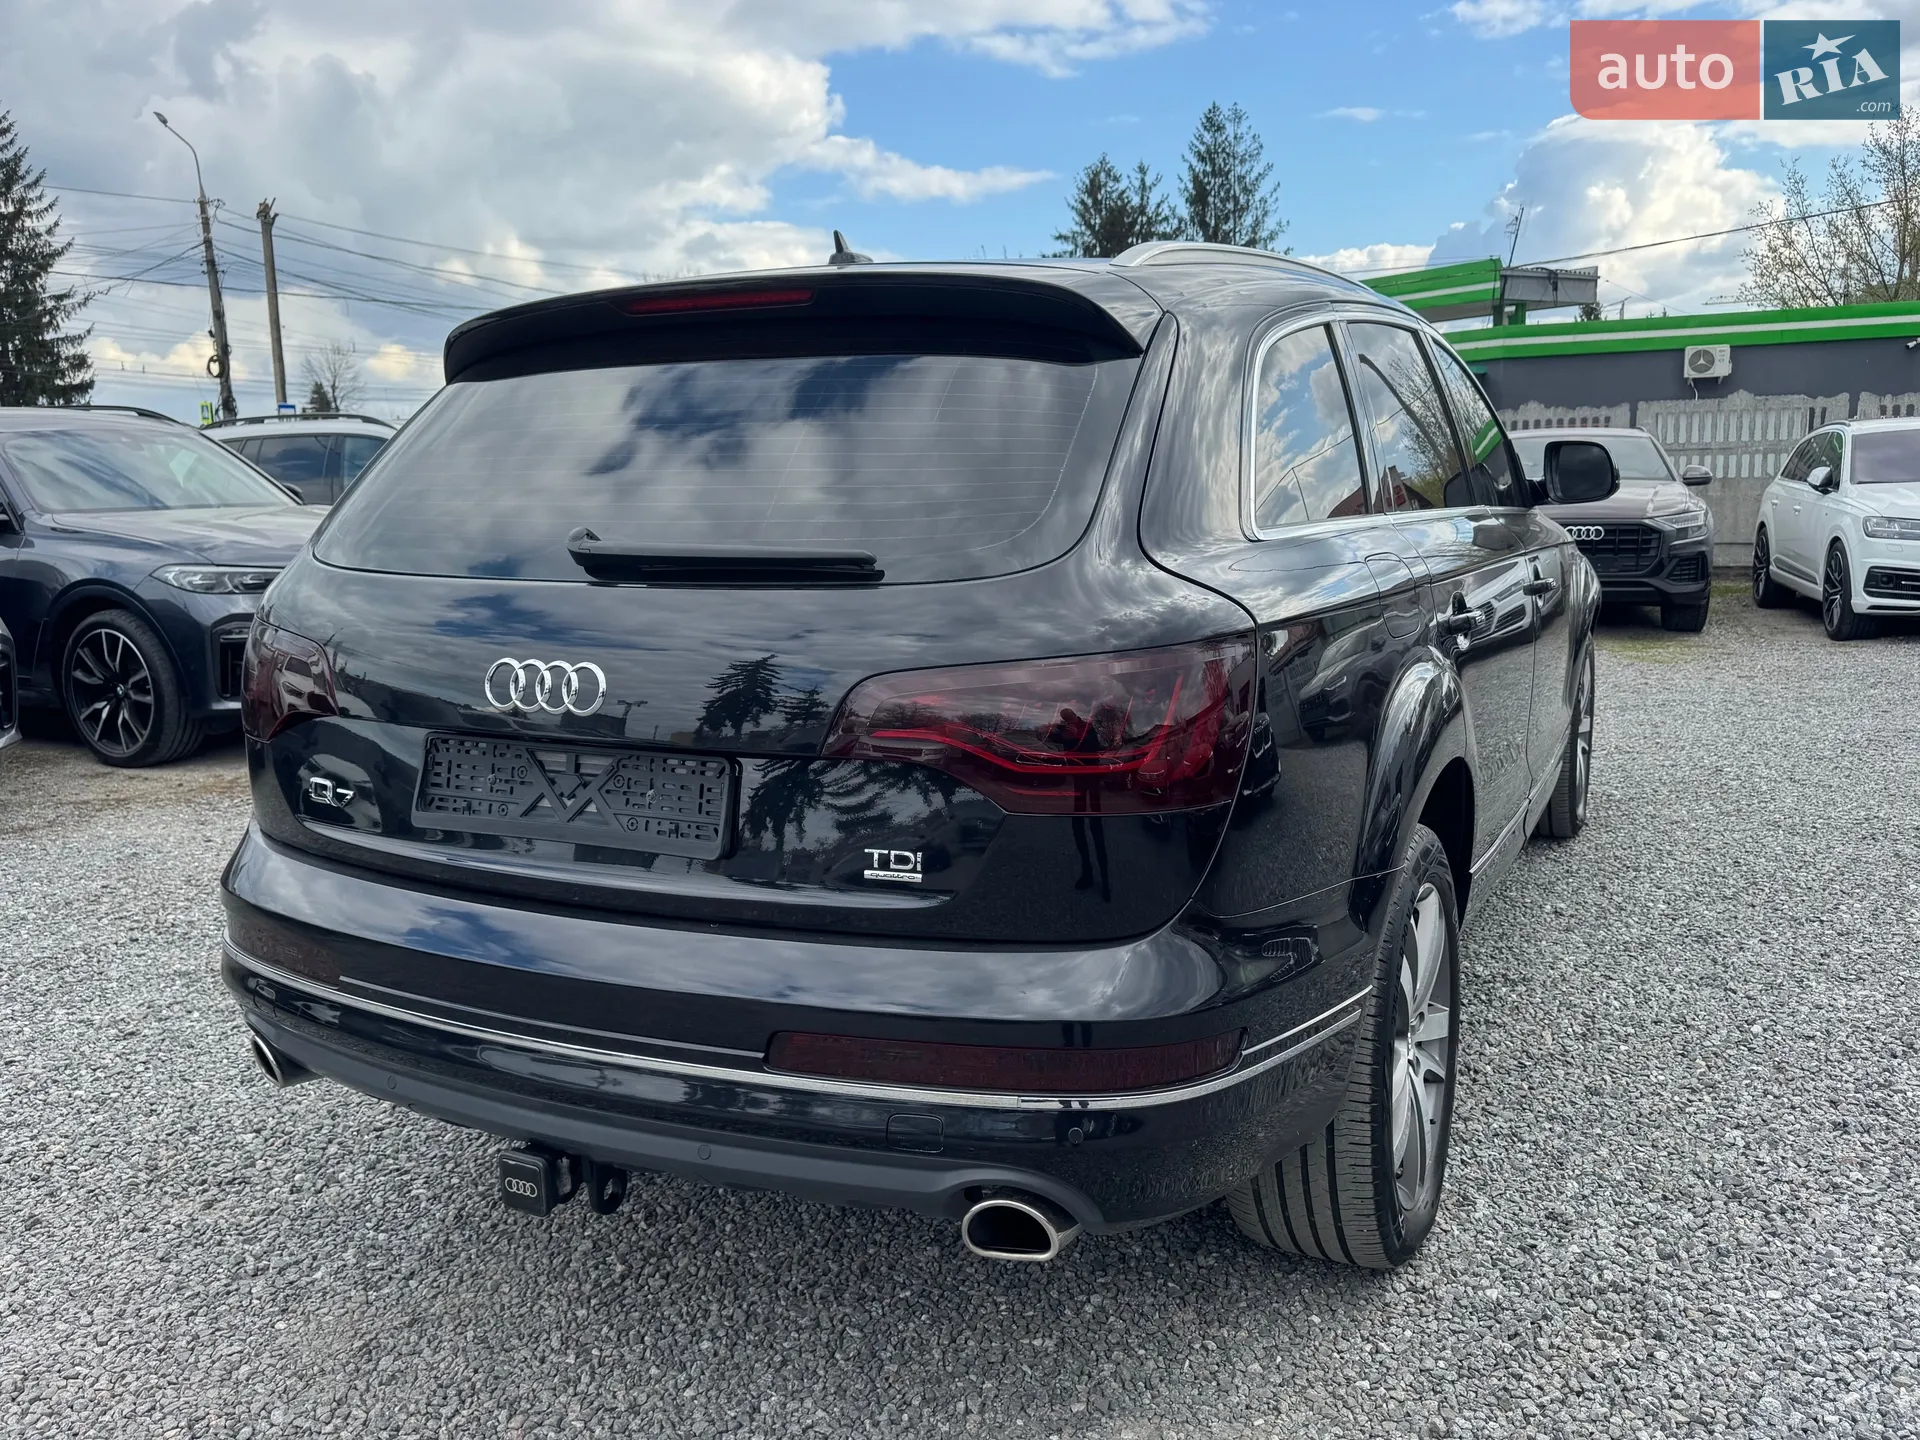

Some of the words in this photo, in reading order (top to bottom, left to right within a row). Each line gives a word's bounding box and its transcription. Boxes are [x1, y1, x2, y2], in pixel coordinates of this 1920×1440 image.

[309, 776, 355, 808] Q7
[864, 848, 922, 871] TDI
[868, 871, 918, 881] quattro
